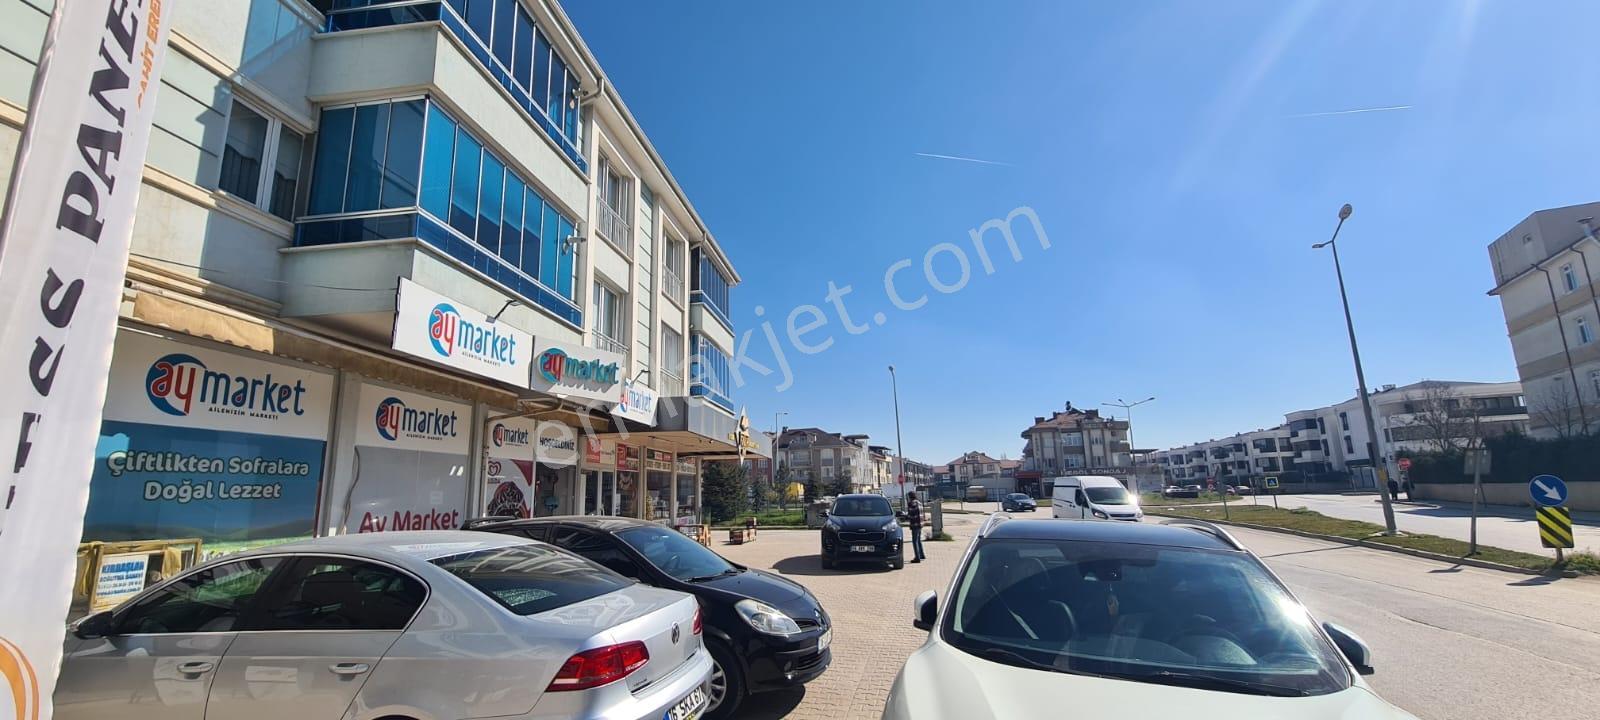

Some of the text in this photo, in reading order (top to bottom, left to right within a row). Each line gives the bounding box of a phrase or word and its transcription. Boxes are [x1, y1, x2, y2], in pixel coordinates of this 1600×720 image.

[56, 0, 142, 244] PANE
[107, 451, 310, 476] Çiftlikten Sofralara
[144, 480, 282, 503] Doğal Lezzet
[392, 507, 459, 532] Market
[680, 692, 695, 716] SKA
